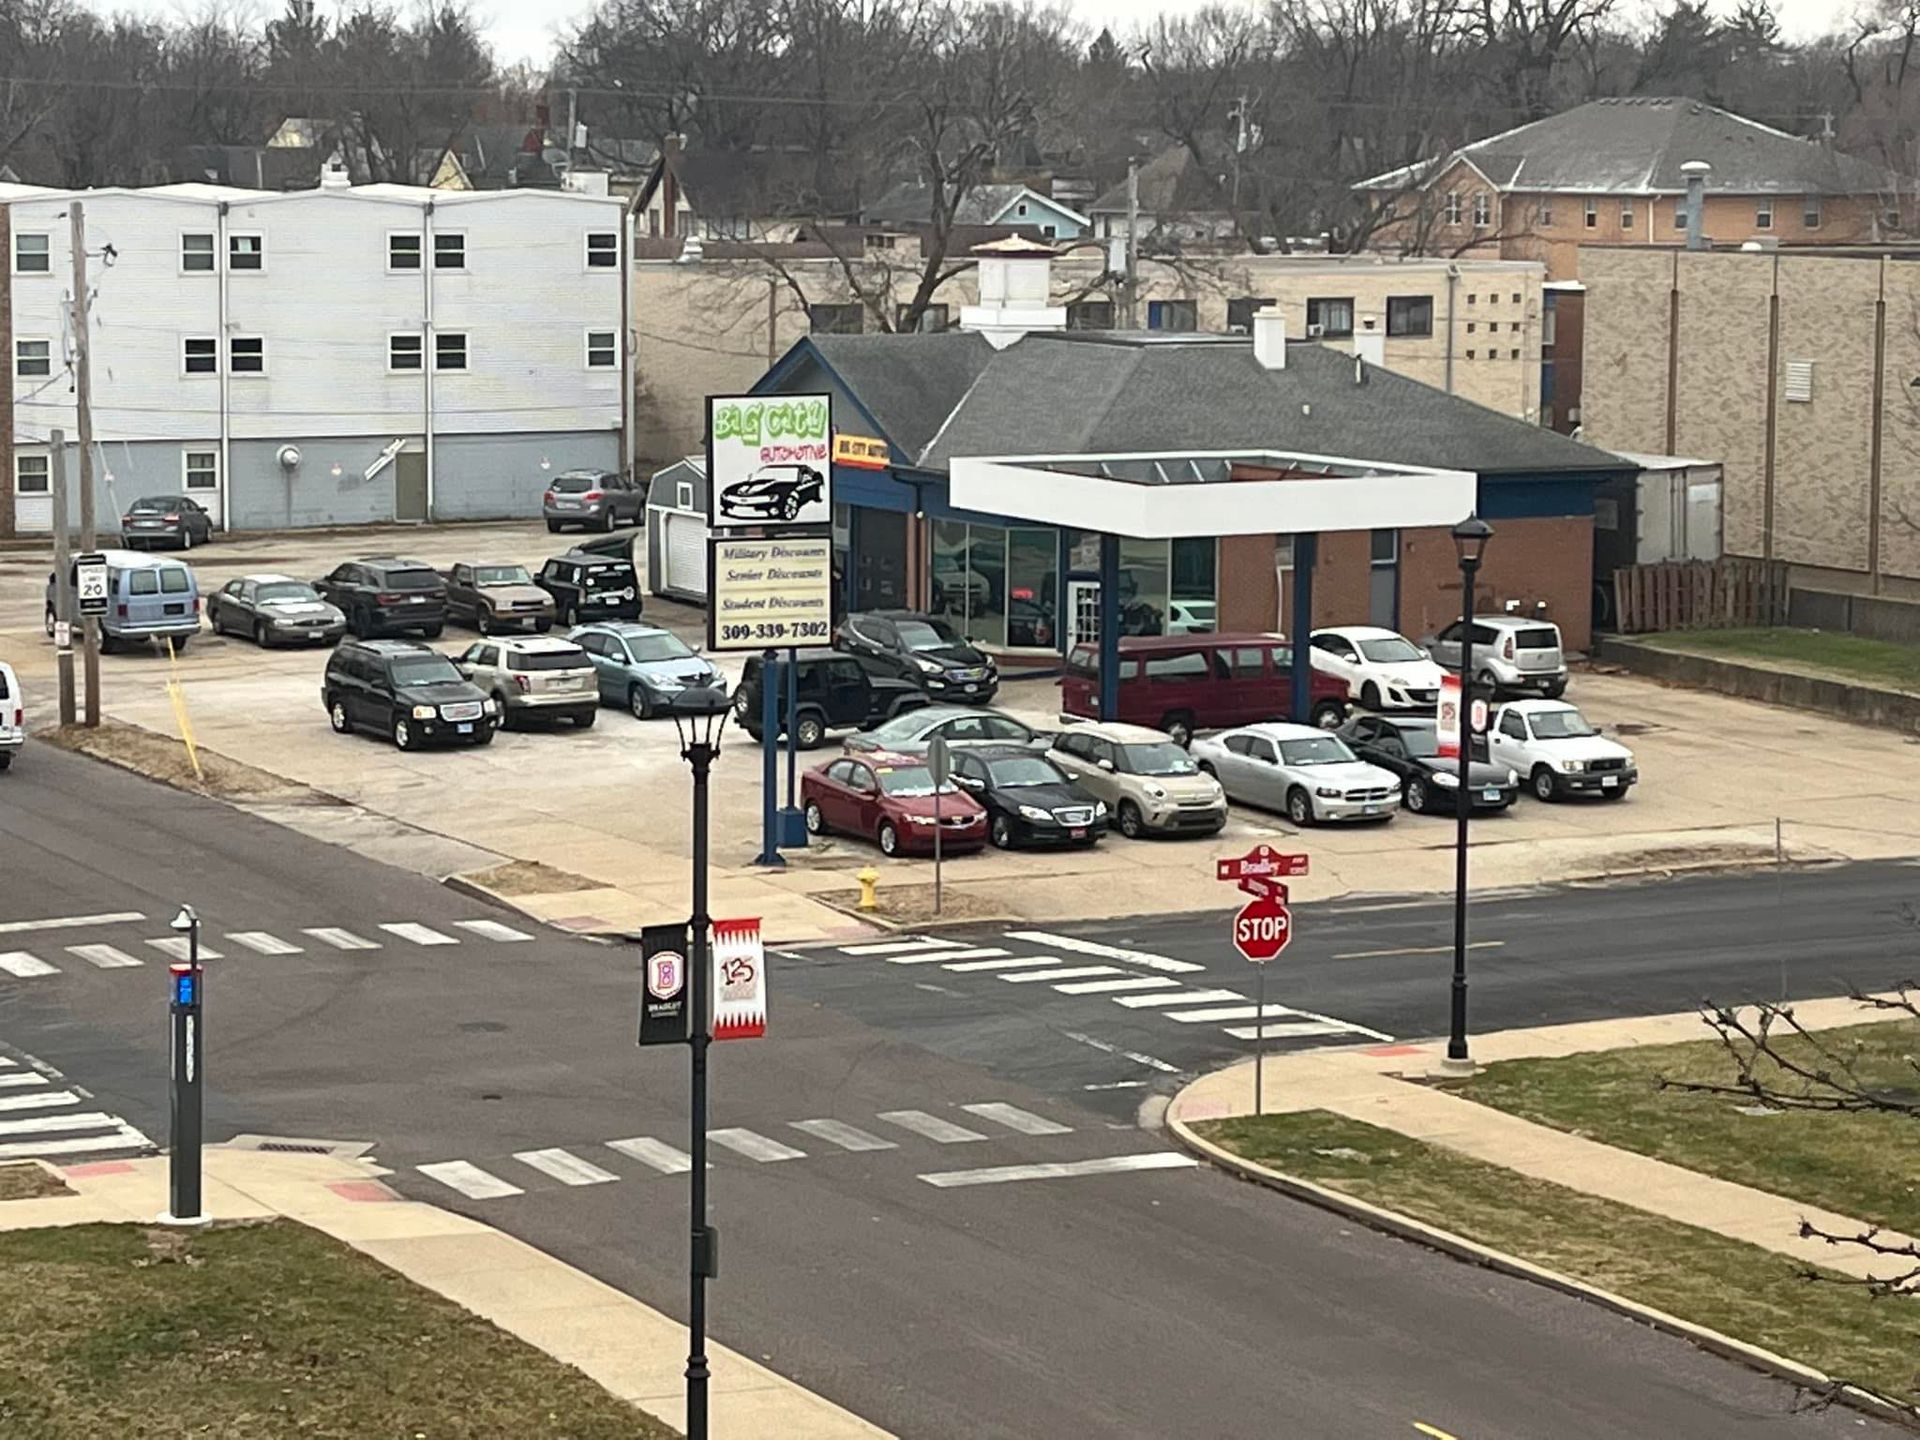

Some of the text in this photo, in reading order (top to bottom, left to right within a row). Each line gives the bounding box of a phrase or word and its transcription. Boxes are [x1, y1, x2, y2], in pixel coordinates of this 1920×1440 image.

[722, 546, 826, 561] Military Discounts
[726, 568, 823, 581] Senior Discounts
[83, 583, 103, 597] 20
[722, 596, 824, 611] Student Discounts
[721, 621, 828, 640] 309-339-7302
[1240, 859, 1280, 876] Bradley
[1238, 917, 1287, 942] STOP
[721, 957, 754, 985] 125
